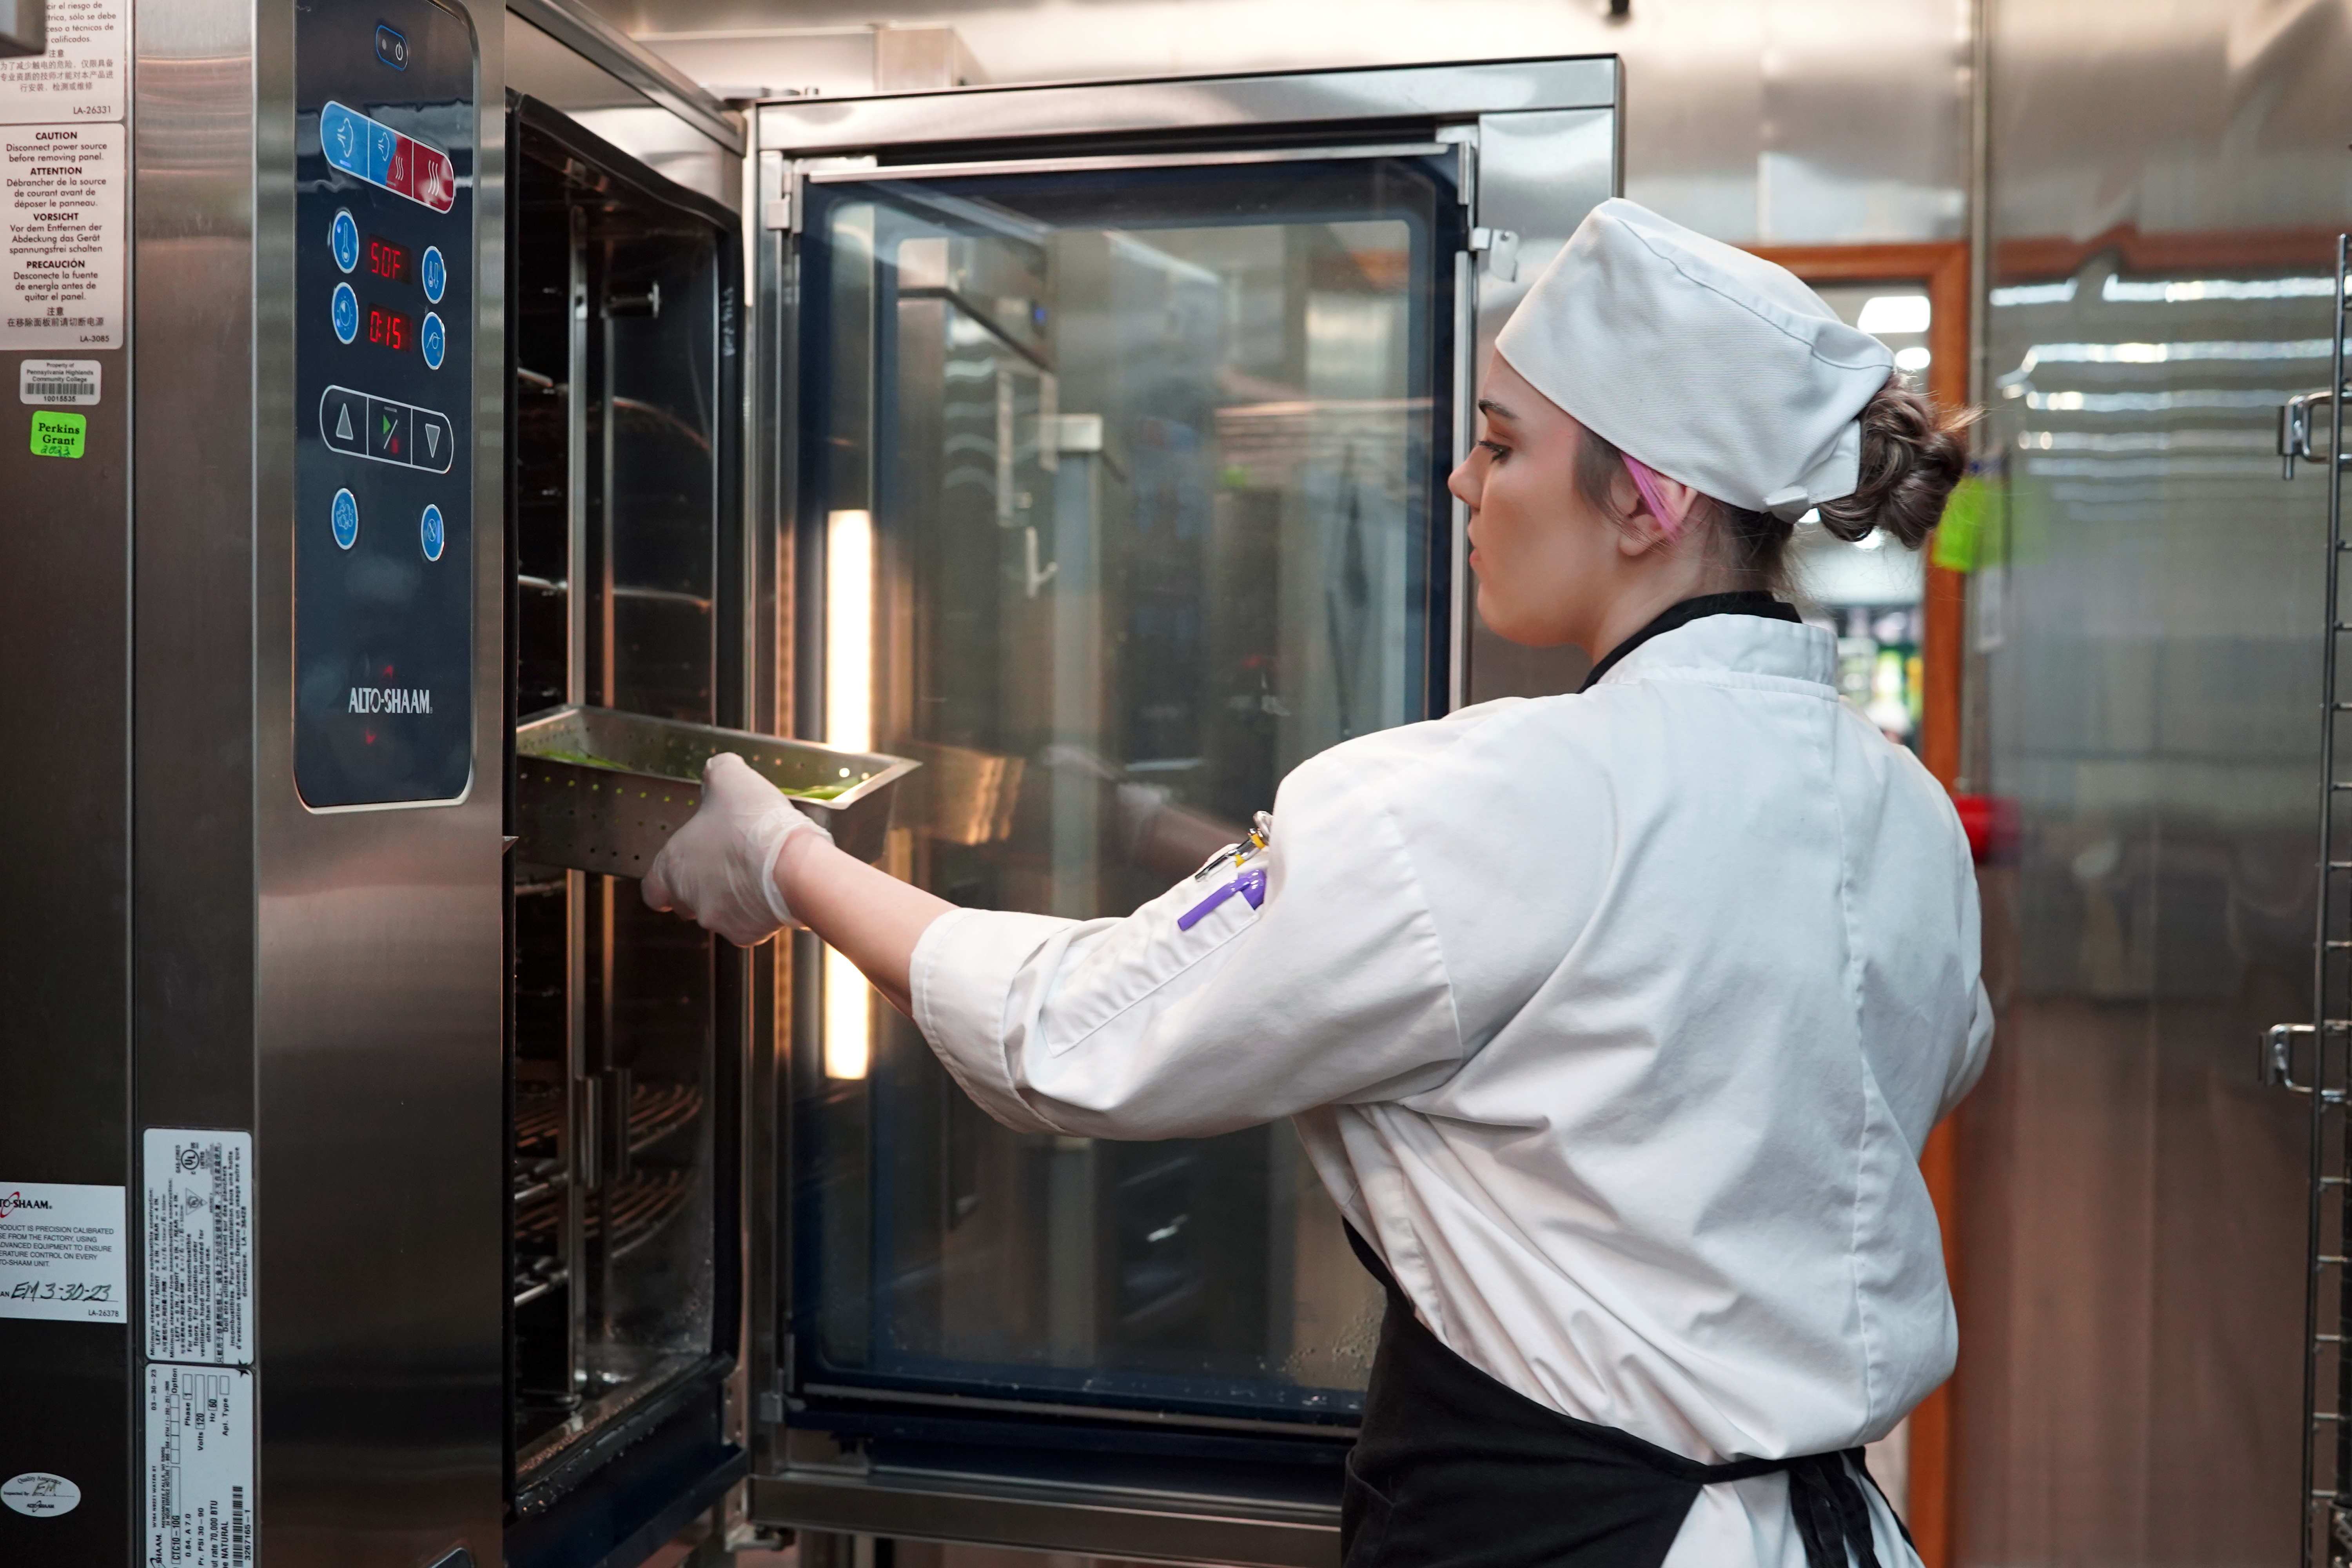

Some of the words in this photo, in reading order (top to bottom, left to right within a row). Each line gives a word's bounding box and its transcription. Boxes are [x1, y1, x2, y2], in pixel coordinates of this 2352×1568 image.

[49, 49, 64, 58] 注意
[73, 106, 111, 114] LA-26331
[36, 132, 77, 140] CAUTION
[9, 153, 35, 162] before
[38, 153, 76, 163] removing
[79, 152, 104, 162] panel.
[30, 167, 82, 176] ATTENTION
[7, 178, 54, 187] Débrancher
[15, 189, 24, 197] de
[86, 187, 96, 196] de
[15, 199, 47, 209] déposer
[49, 199, 56, 207] le
[60, 200, 98, 209] panneau.
[33, 213, 79, 221] VORSICHT
[27, 224, 44, 232] dem
[47, 223, 85, 232] Entfernen
[89, 223, 102, 231] der
[12, 234, 57, 244] Abdeckung
[60, 234, 74, 242] das
[10, 245, 66, 255] spannungsfrei
[69, 245, 102, 253] schalten
[26, 258, 85, 269] PRECAUCIÓN
[62, 271, 69, 279] la
[73, 270, 98, 279] fuente
[87, 281, 96, 289] de
[25, 294, 48, 303] quitar
[51, 292, 58, 301] el
[61, 292, 86, 302] panel.
[47, 307, 64, 316] 注意
[370, 311, 401, 349] 0:15
[38, 423, 80, 435] Perkins
[43, 435, 75, 445] Grant
[348, 687, 430, 714] ALTO-SHAAM
[188, 1295, 192, 1303] on
[208, 1399, 217, 1408] 60
[209, 1413, 216, 1422] Hz
[210, 1518, 218, 1541] 70,000
